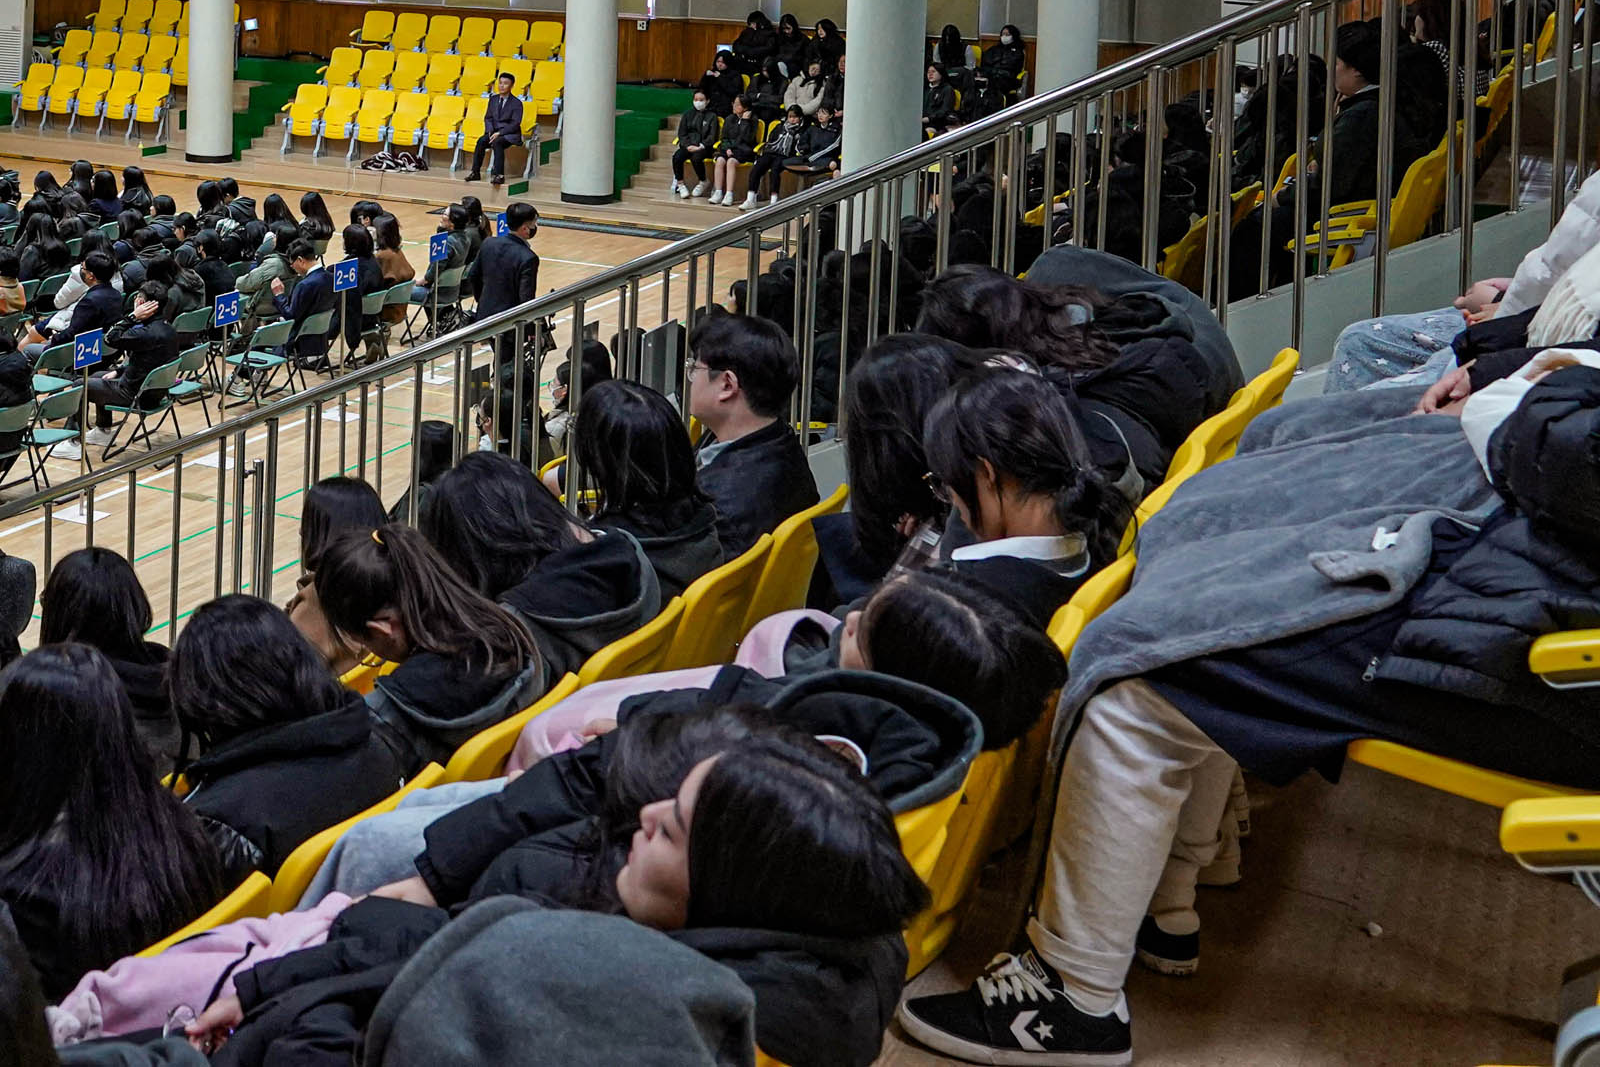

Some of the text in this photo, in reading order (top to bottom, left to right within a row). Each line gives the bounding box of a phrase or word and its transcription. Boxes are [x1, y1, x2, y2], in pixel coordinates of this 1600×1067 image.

[432, 240, 446, 256] 2-7
[336, 267, 356, 285] 2-6
[218, 302, 237, 320] 2-5
[77, 342, 99, 362] 2-4
